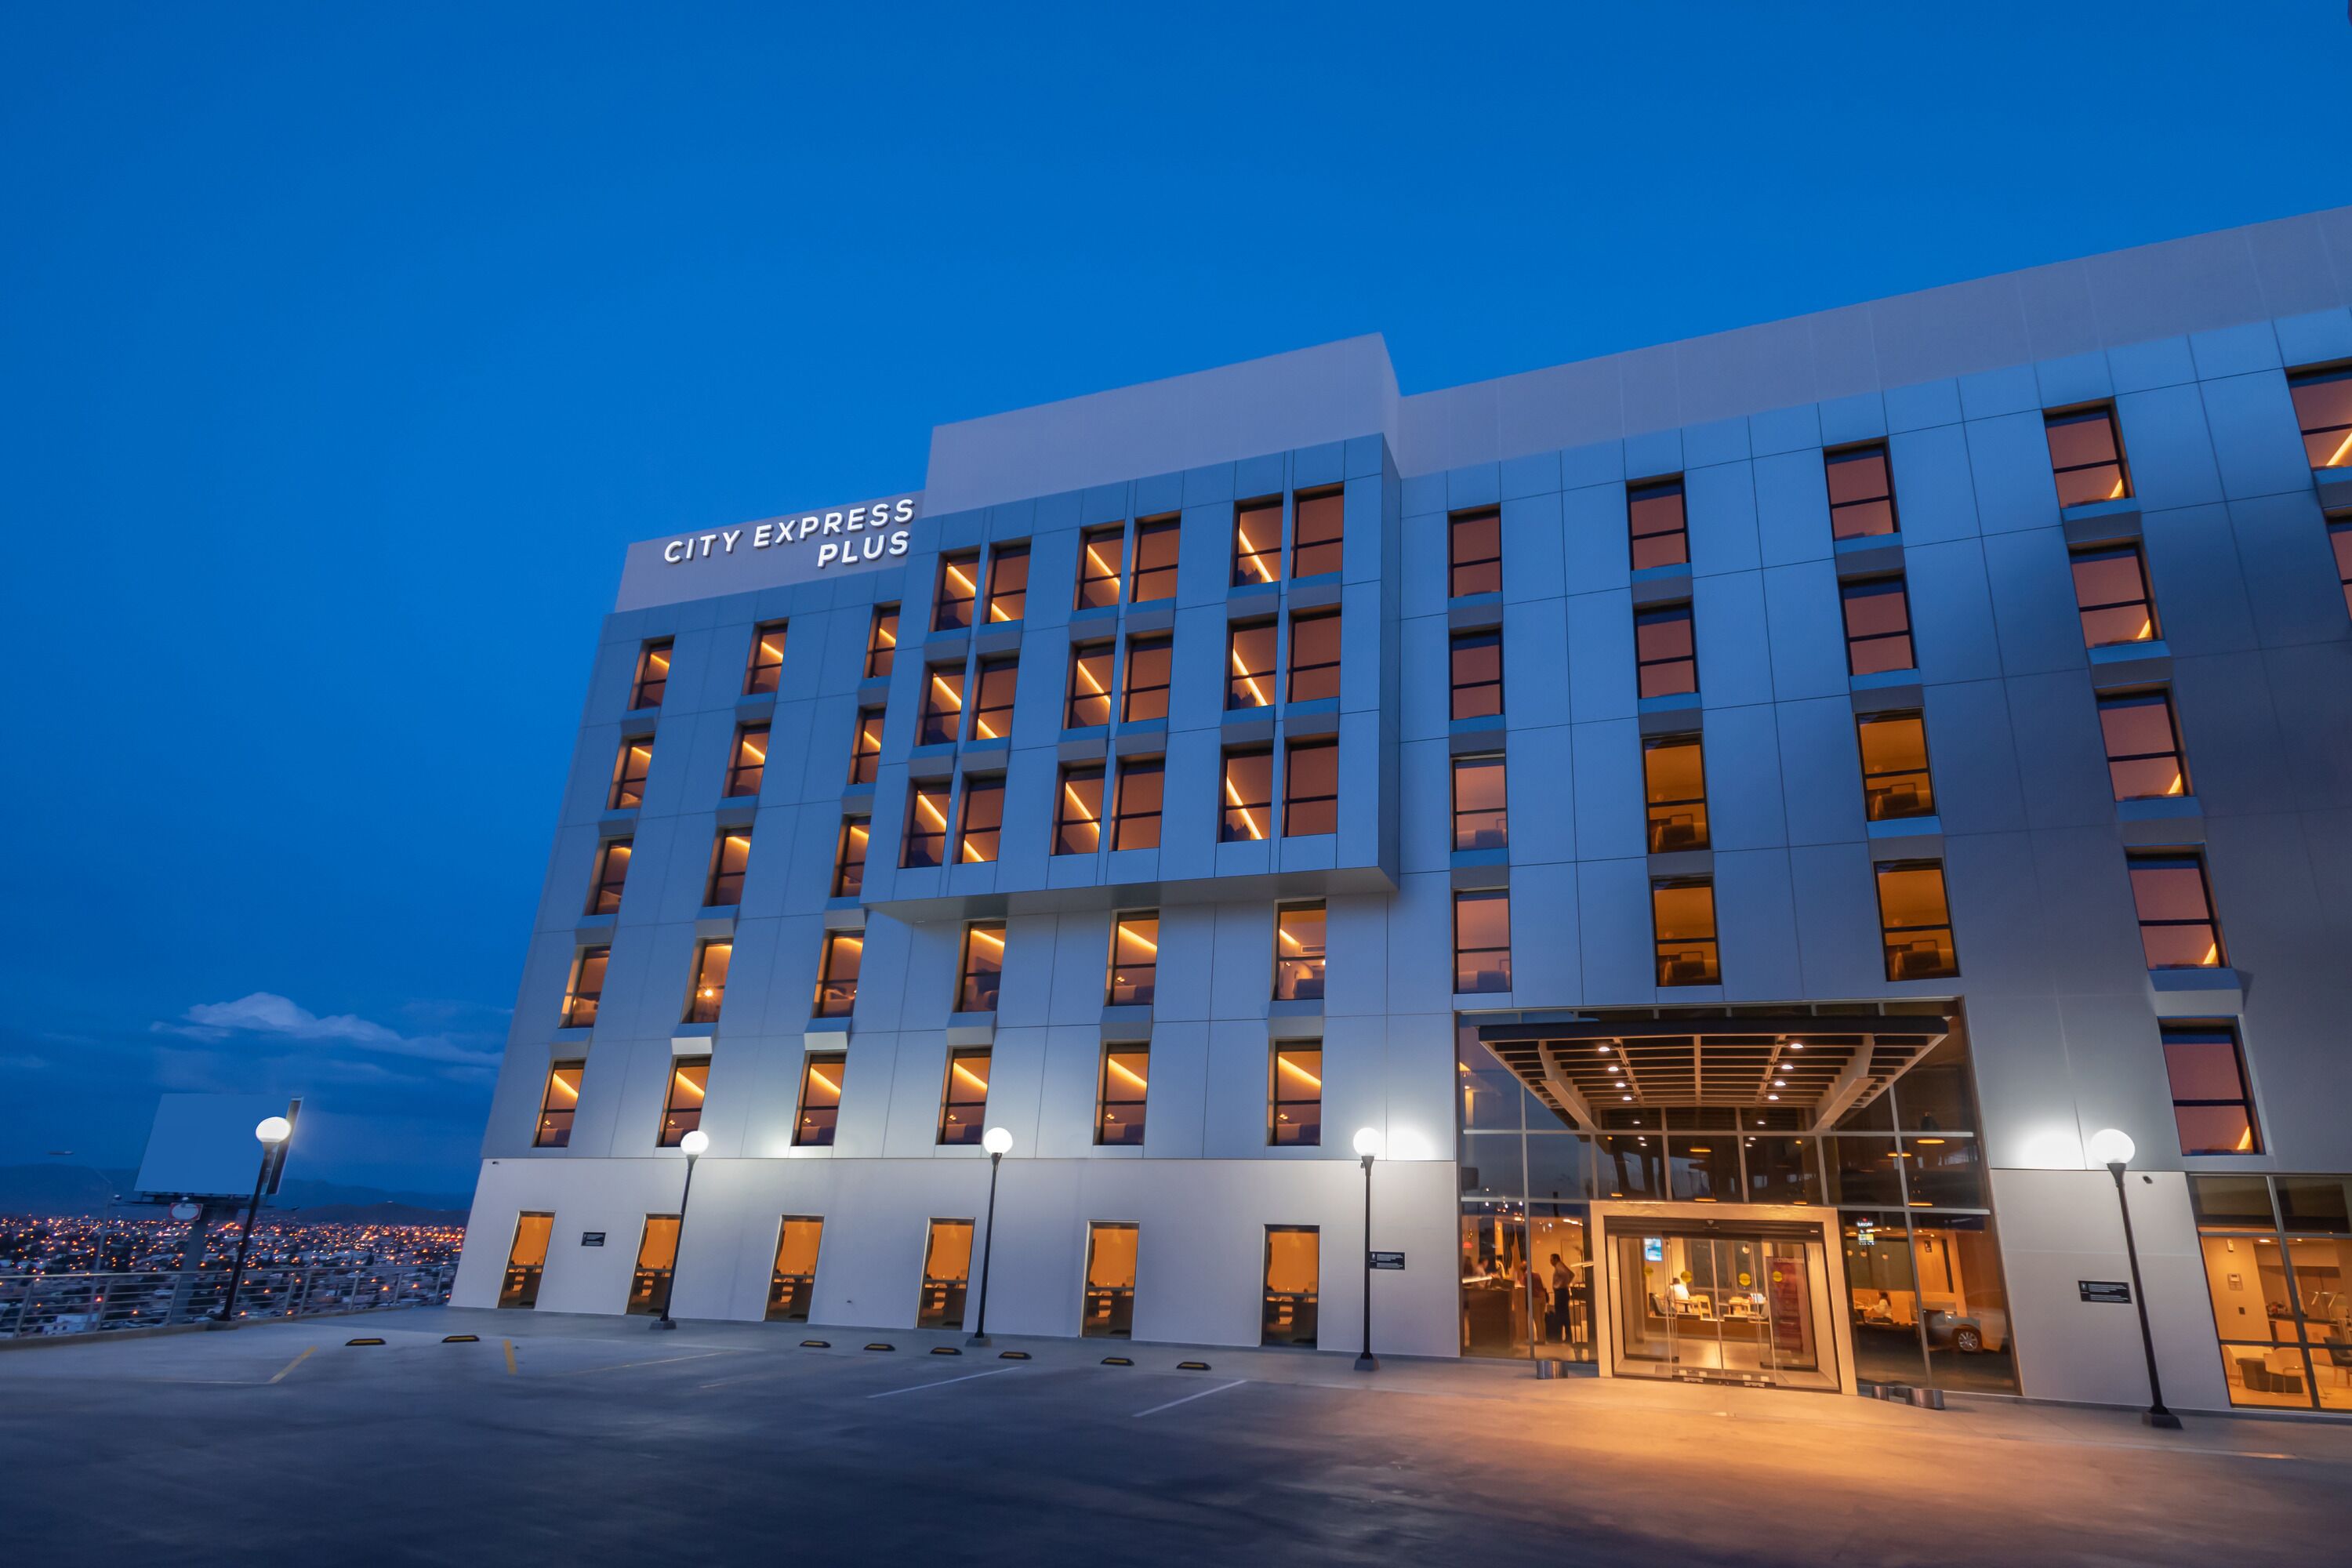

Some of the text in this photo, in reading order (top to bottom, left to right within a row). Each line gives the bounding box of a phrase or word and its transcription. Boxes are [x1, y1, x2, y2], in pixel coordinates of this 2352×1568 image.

[664, 499, 915, 564] CITY EXPRESS
[817, 531, 911, 568] PLUS
